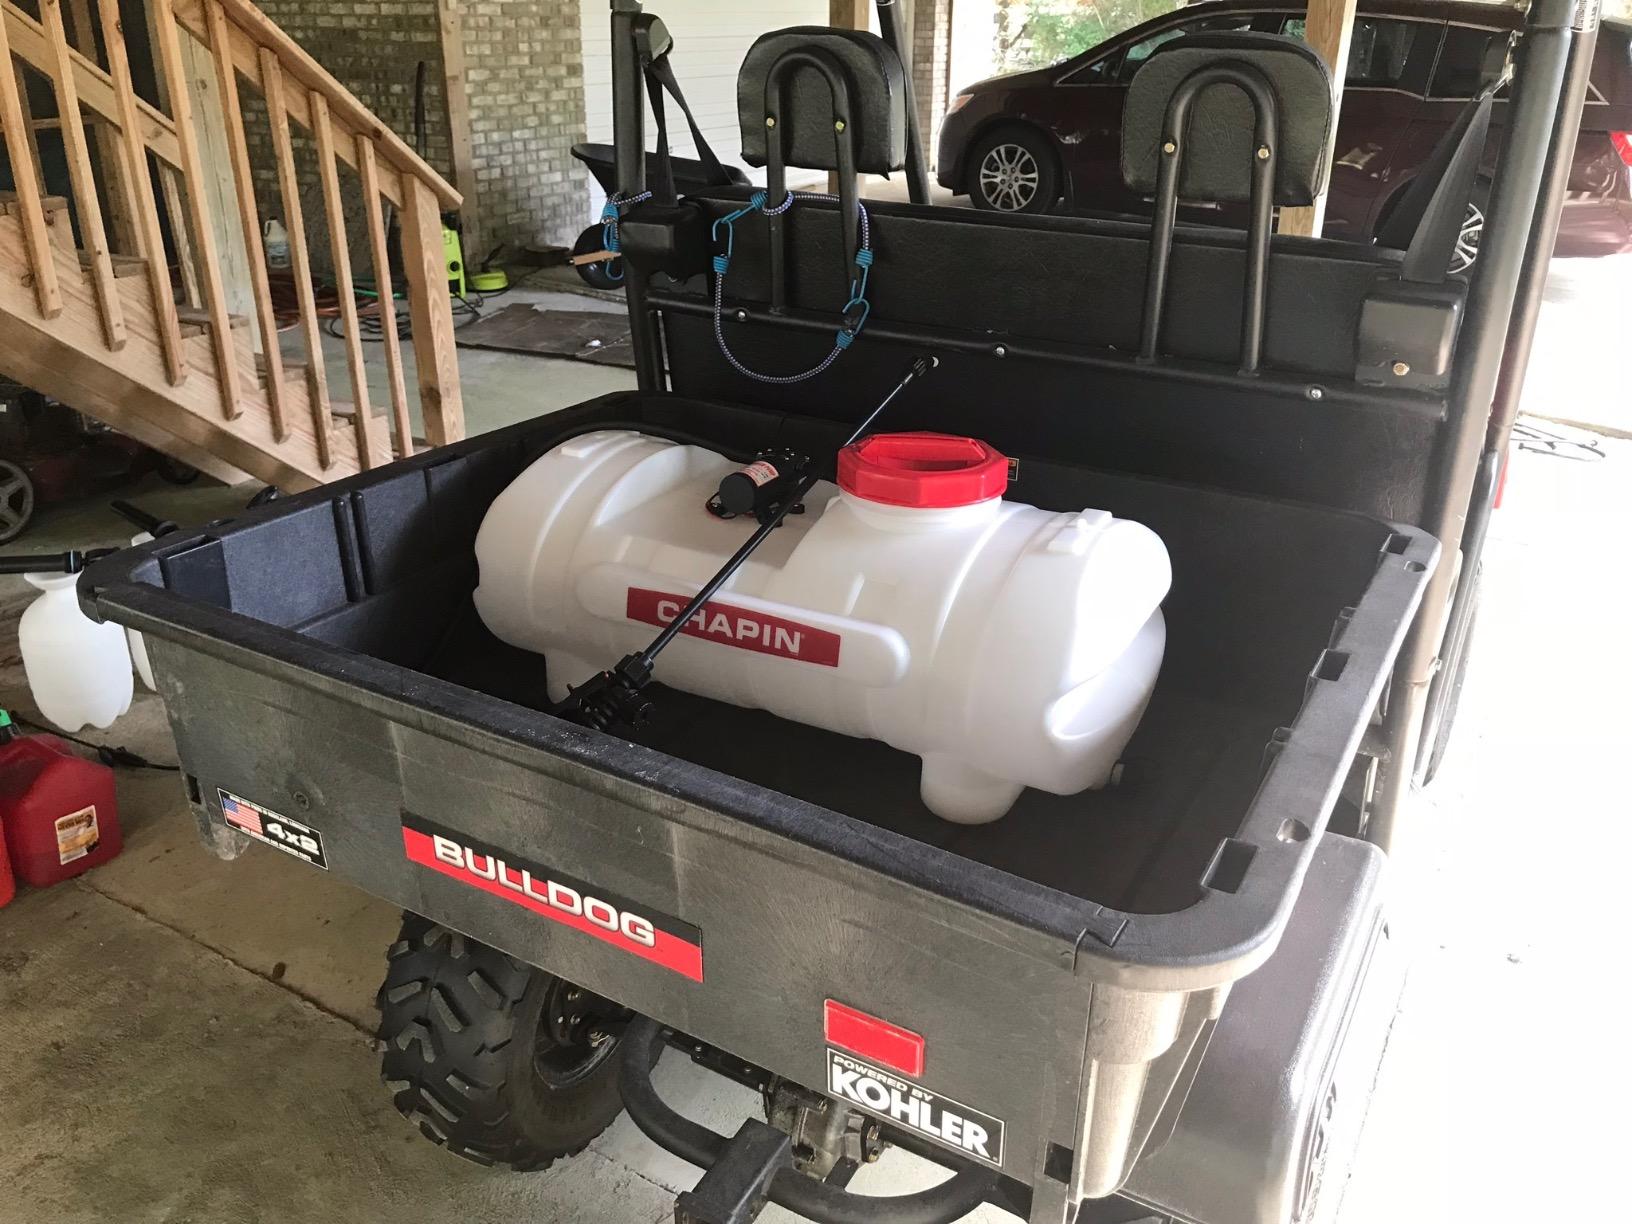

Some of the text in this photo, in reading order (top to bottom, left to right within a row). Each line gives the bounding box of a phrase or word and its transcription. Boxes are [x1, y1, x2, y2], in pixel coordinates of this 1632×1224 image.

[657, 600, 801, 656] CHAPIN
[433, 834, 656, 948] BULLDOG
[832, 1063, 991, 1159] KOHLER
[833, 1055, 933, 1102] POWERED BY
